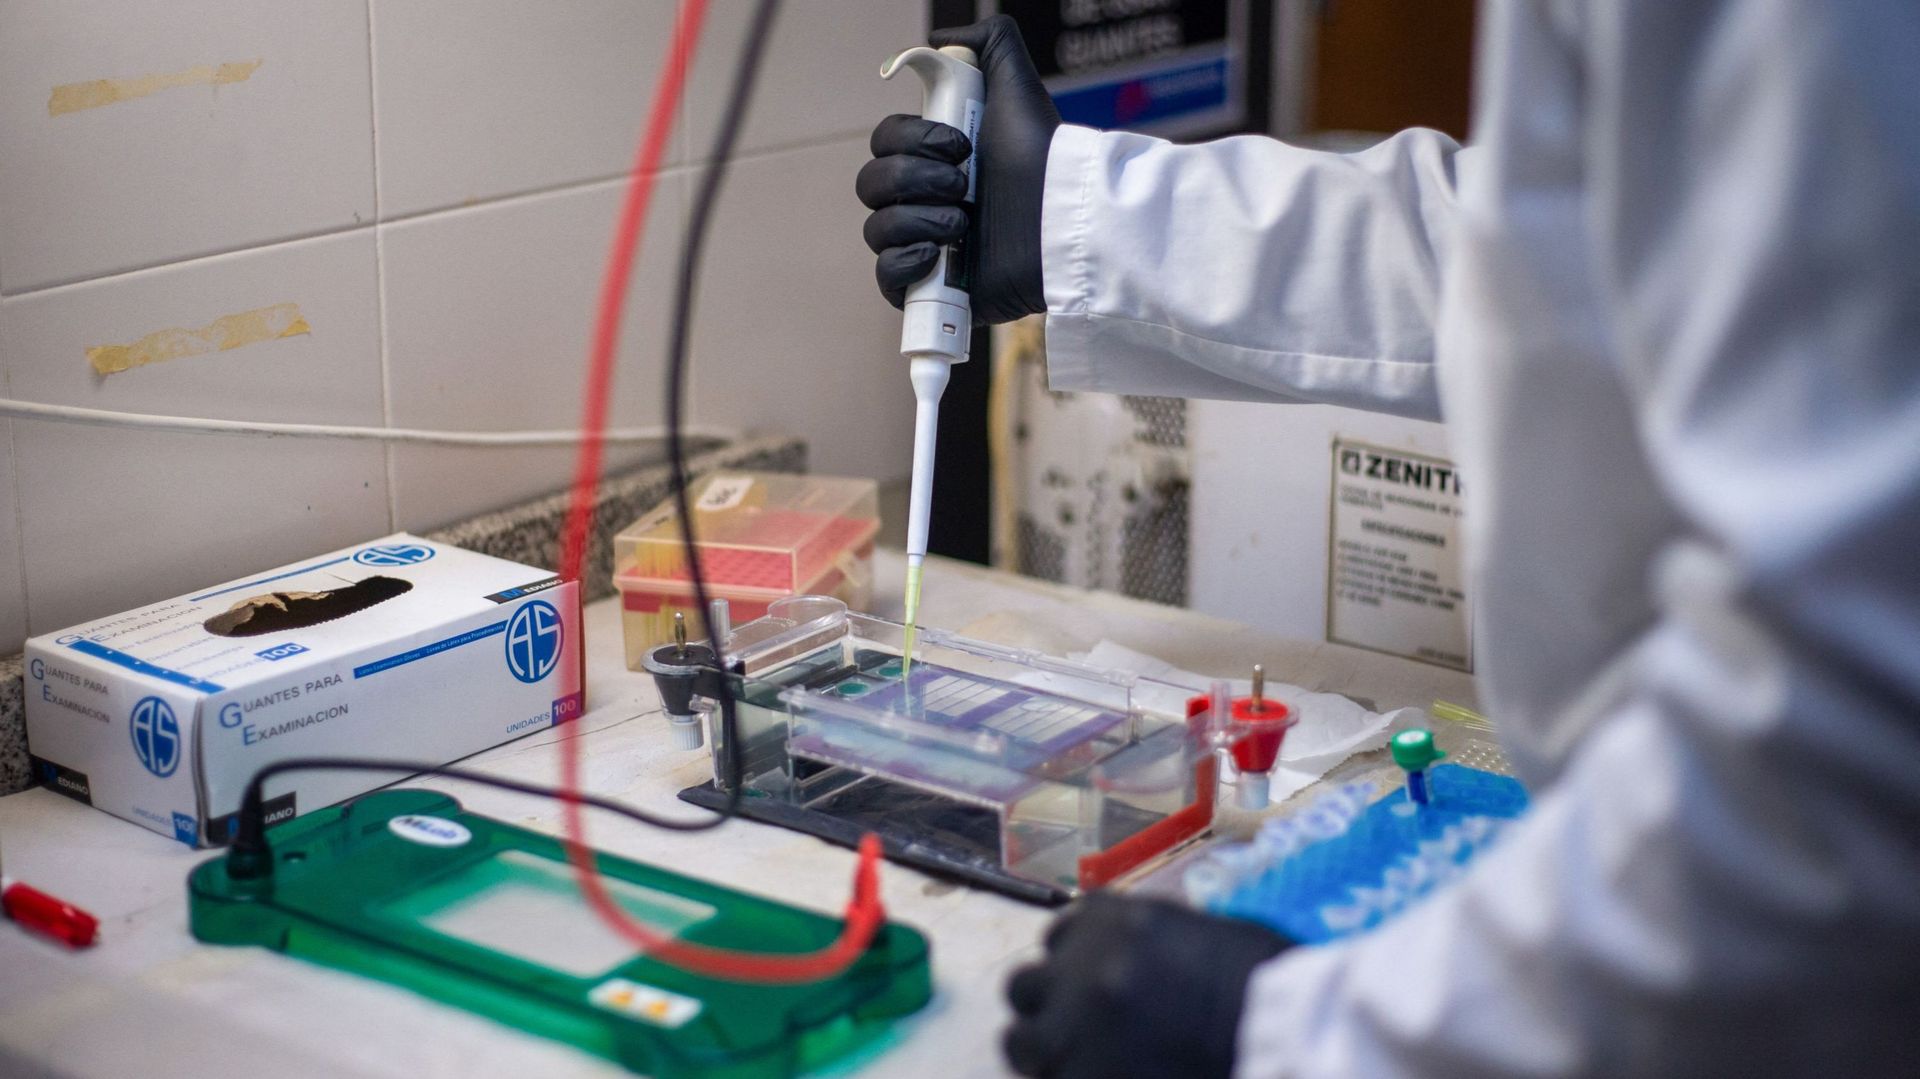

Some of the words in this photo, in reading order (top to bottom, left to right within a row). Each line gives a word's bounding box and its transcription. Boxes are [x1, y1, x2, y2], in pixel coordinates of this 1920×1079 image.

[262, 645, 301, 659] 100
[31, 659, 81, 686] GUANTES
[83, 678, 109, 695] PARA
[43, 684, 111, 723] EXAMINACION
[219, 686, 301, 729] GUANTES
[305, 674, 343, 693] PARA
[506, 712, 550, 733] UNIDADES
[554, 699, 577, 716] 100
[243, 704, 349, 746] EXAMINACION
